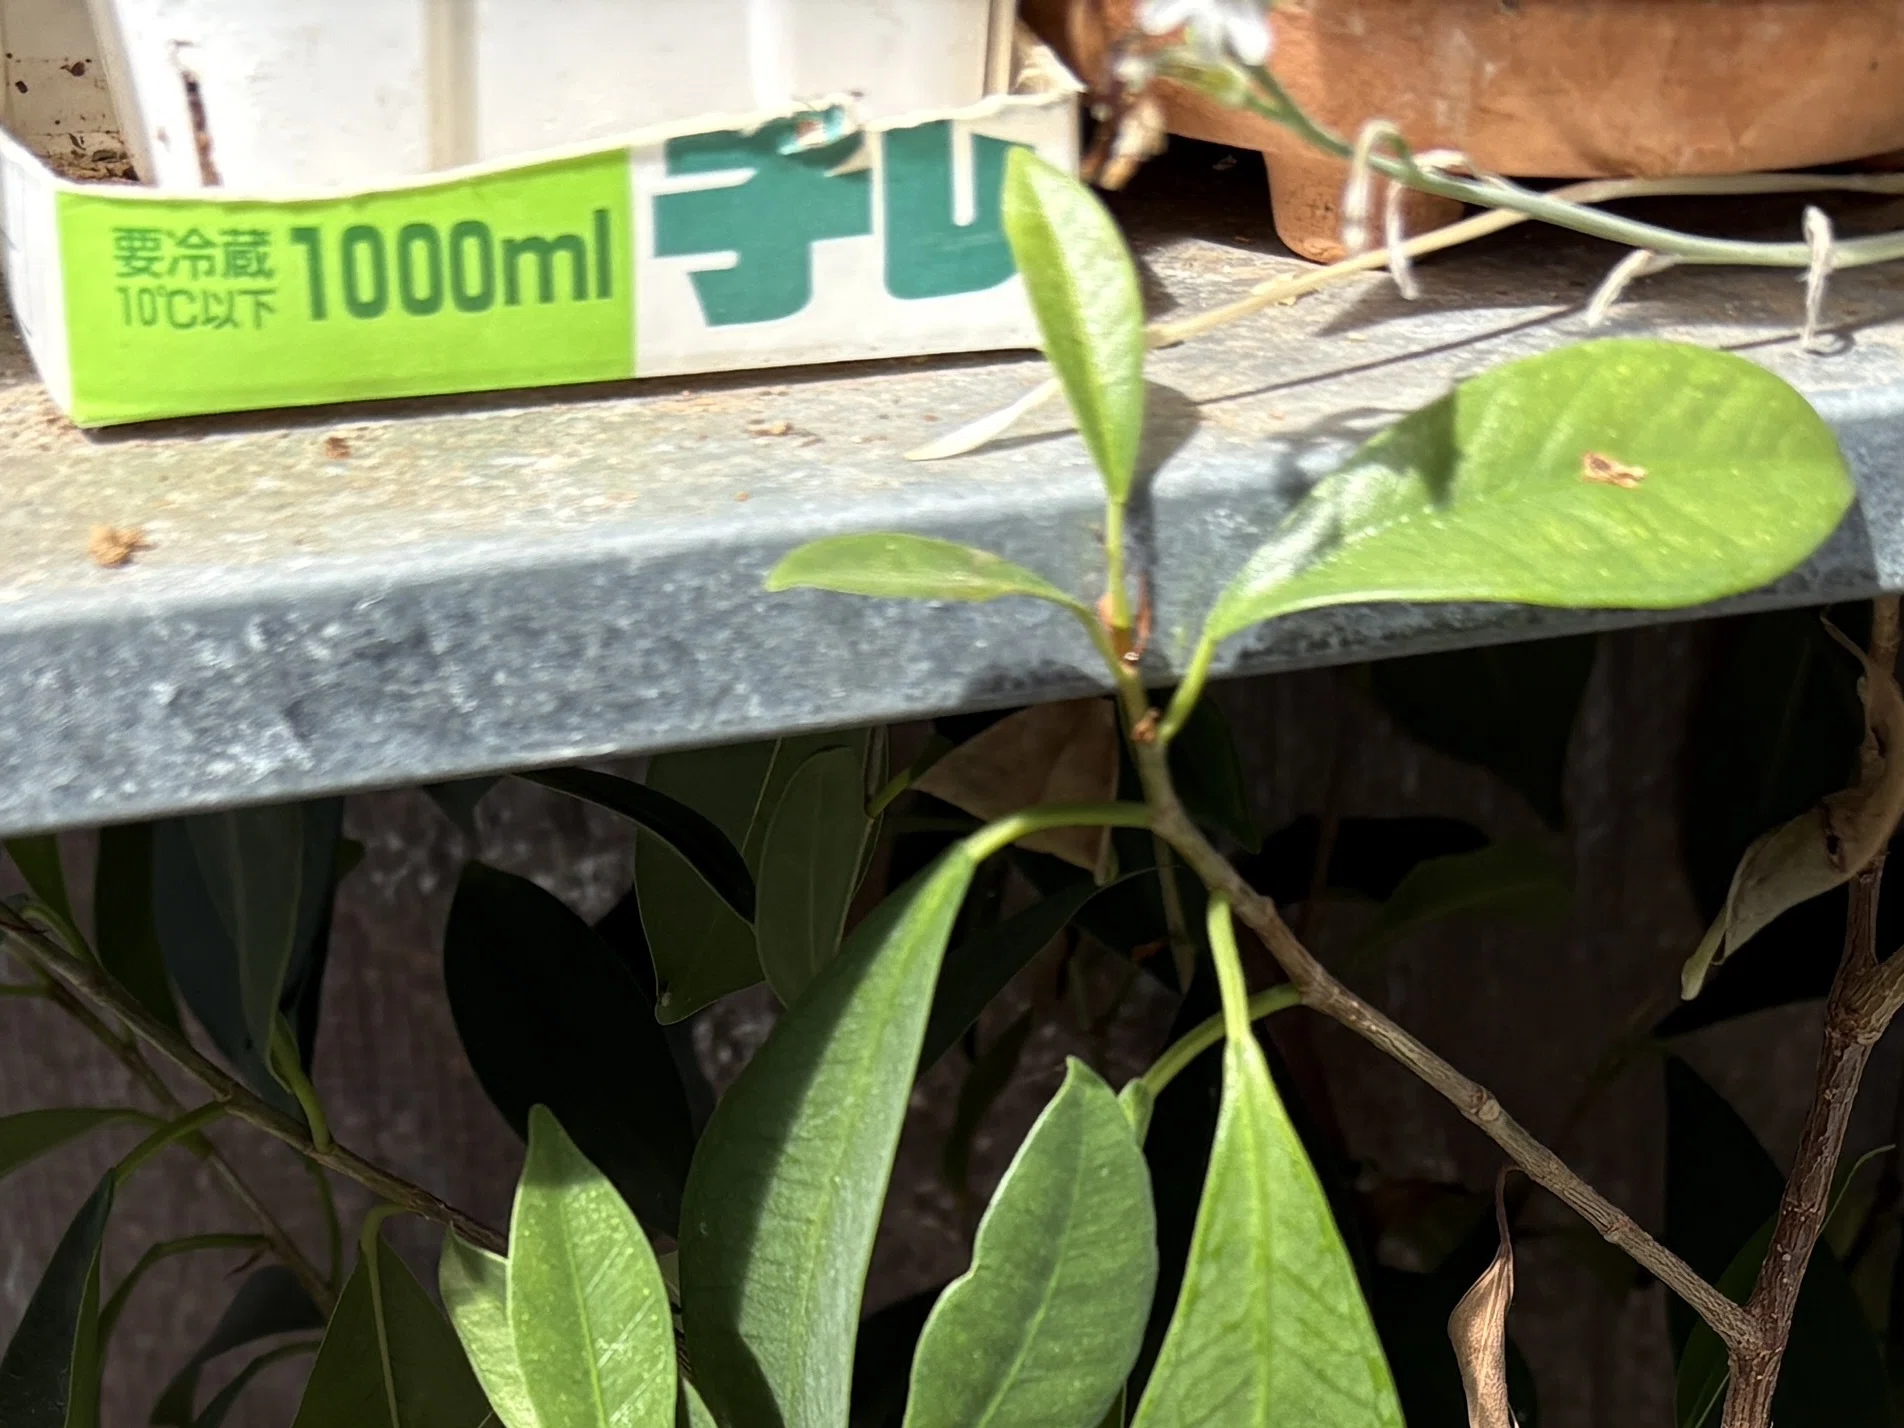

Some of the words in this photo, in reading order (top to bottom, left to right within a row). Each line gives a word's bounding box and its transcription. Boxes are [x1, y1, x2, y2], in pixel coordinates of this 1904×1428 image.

[111, 226, 277, 282] 要冷蔵
[288, 208, 613, 322] 1000ml
